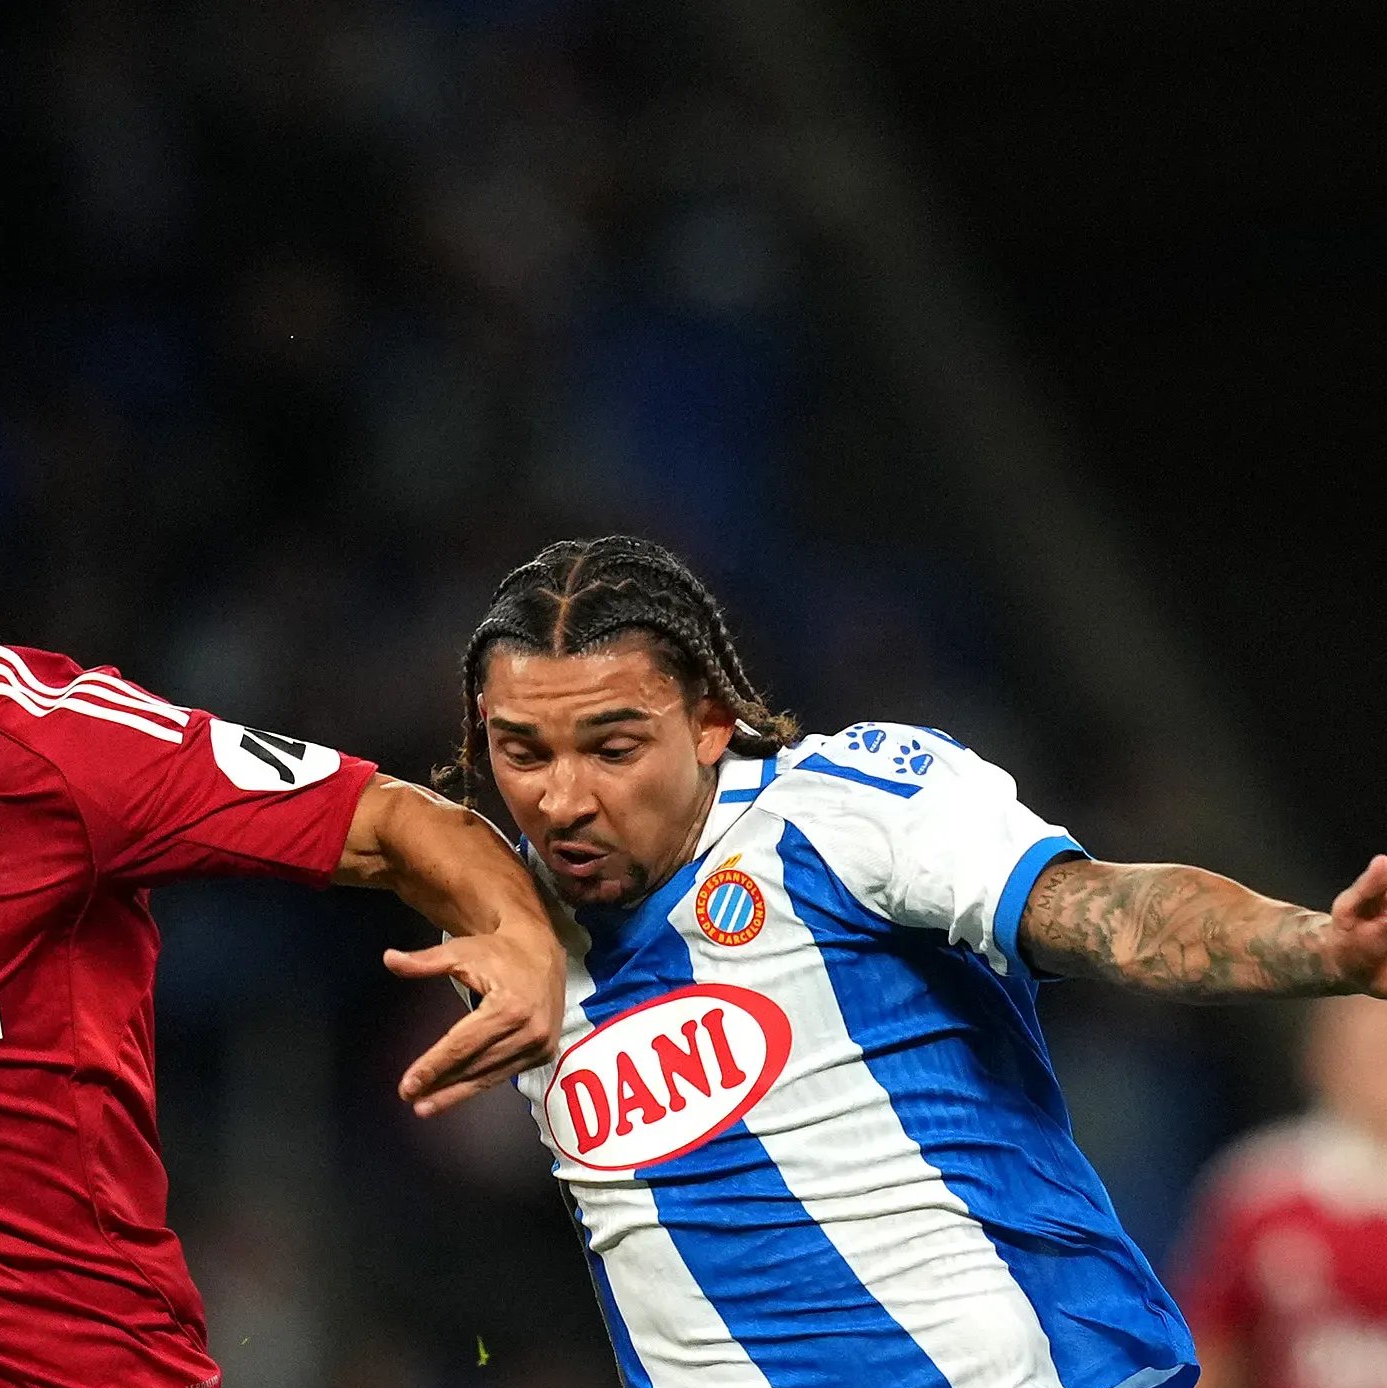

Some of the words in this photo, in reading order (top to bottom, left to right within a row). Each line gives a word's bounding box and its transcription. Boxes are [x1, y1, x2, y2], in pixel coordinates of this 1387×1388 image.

[705, 871, 758, 896] ESPANYOL
[718, 901, 764, 945] BARCELONA
[559, 1006, 748, 1155] DANI
